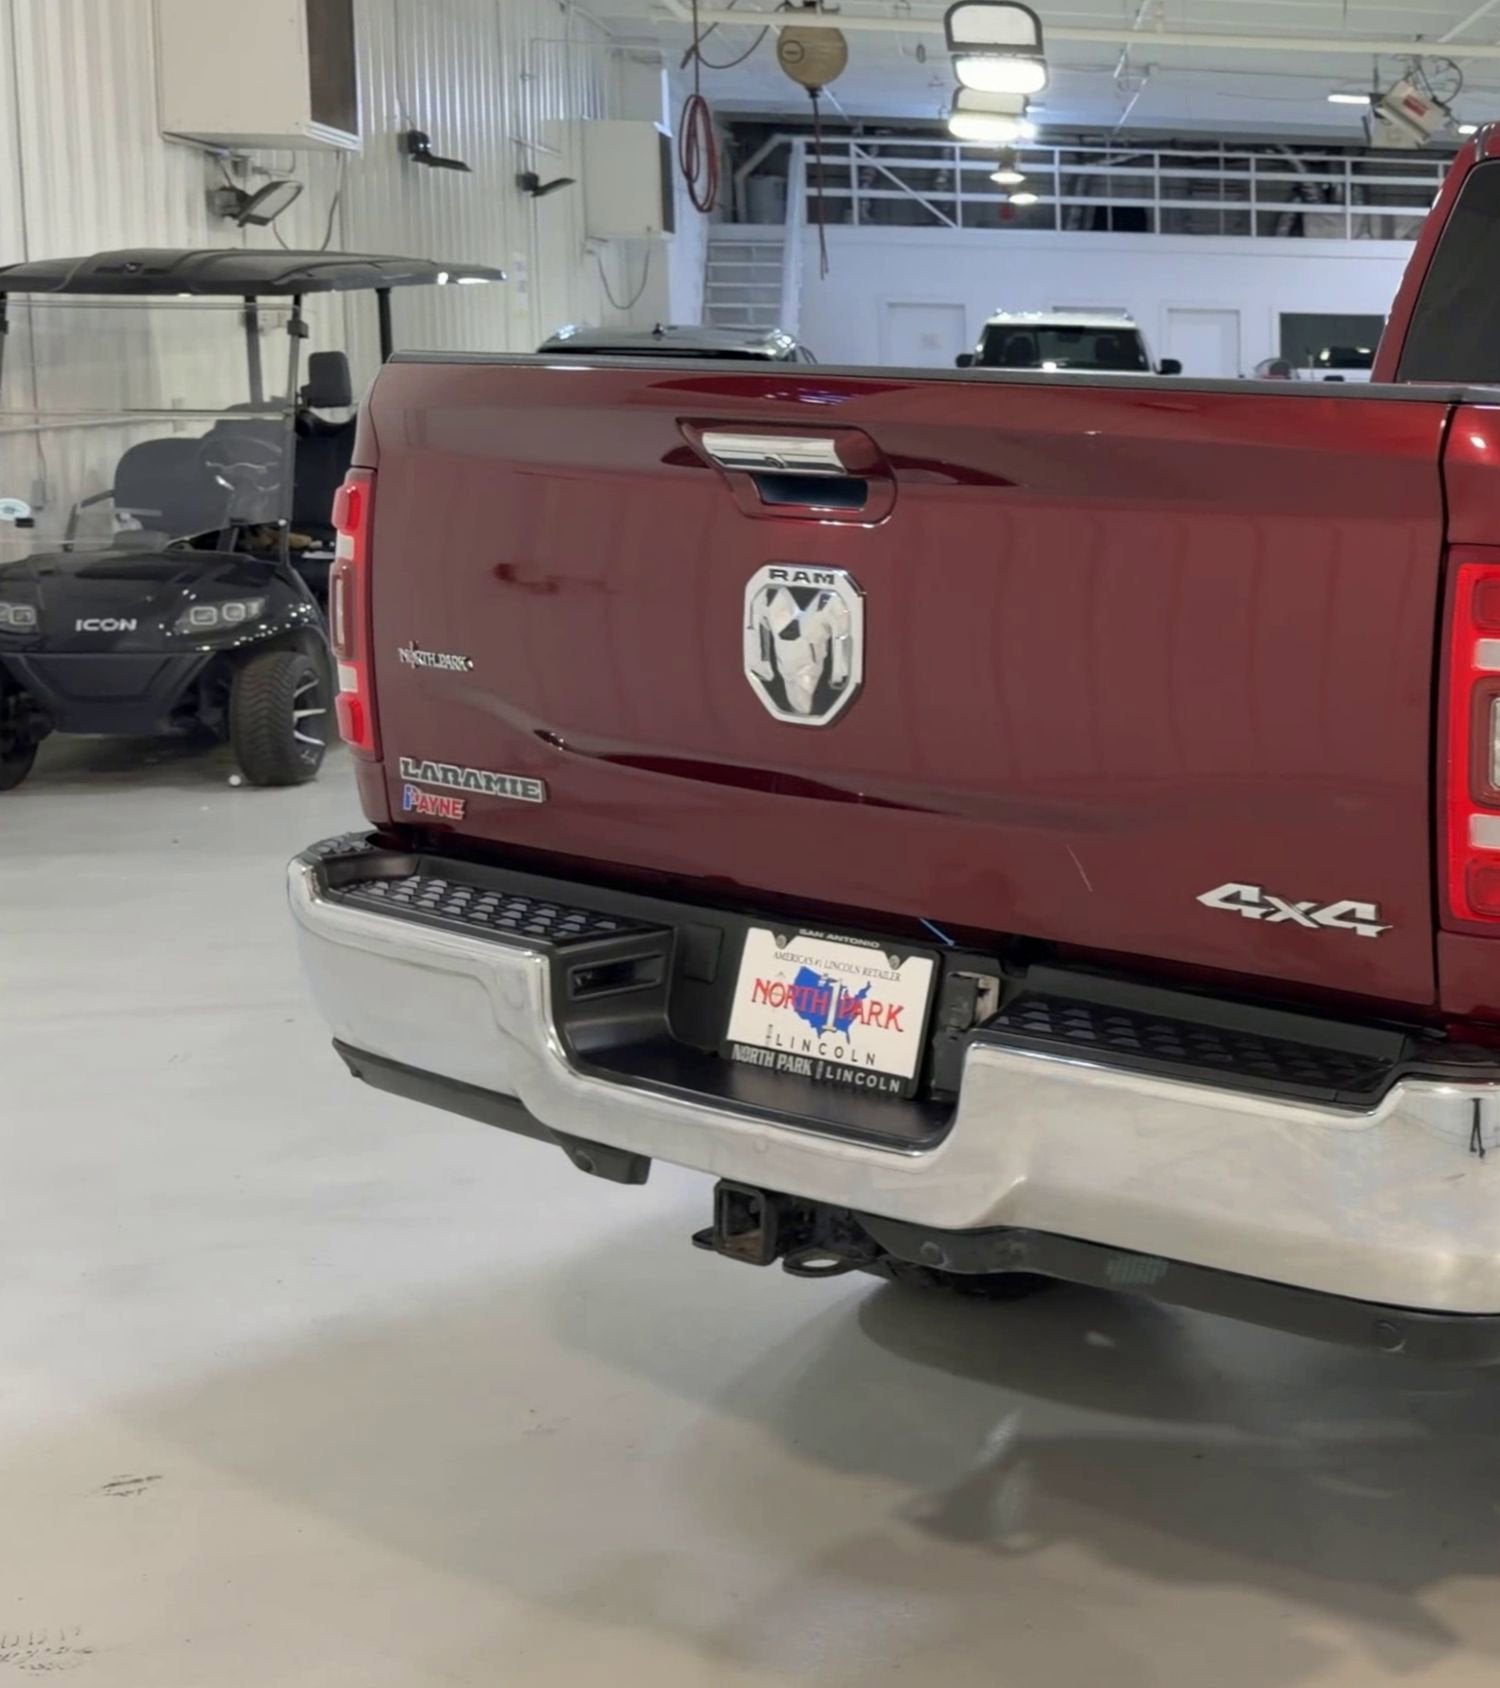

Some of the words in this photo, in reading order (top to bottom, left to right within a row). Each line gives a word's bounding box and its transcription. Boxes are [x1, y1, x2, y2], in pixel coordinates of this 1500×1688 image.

[768, 568, 835, 585] RAM
[75, 618, 138, 632] ICON
[400, 758, 544, 803] LARAMIE
[403, 784, 465, 820] PAYNE
[799, 928, 824, 938] SAN
[826, 933, 881, 949] ANTONIO
[824, 960, 860, 975] LINCOLN
[862, 967, 901, 982] RETAILER
[751, 977, 829, 1016] NORTH
[837, 988, 905, 1033] PARK
[775, 1033, 877, 1066] LINCOLN
[731, 1043, 774, 1067] NORTH
[775, 1052, 814, 1077] PARK
[825, 1065, 900, 1093] LINCOLN
